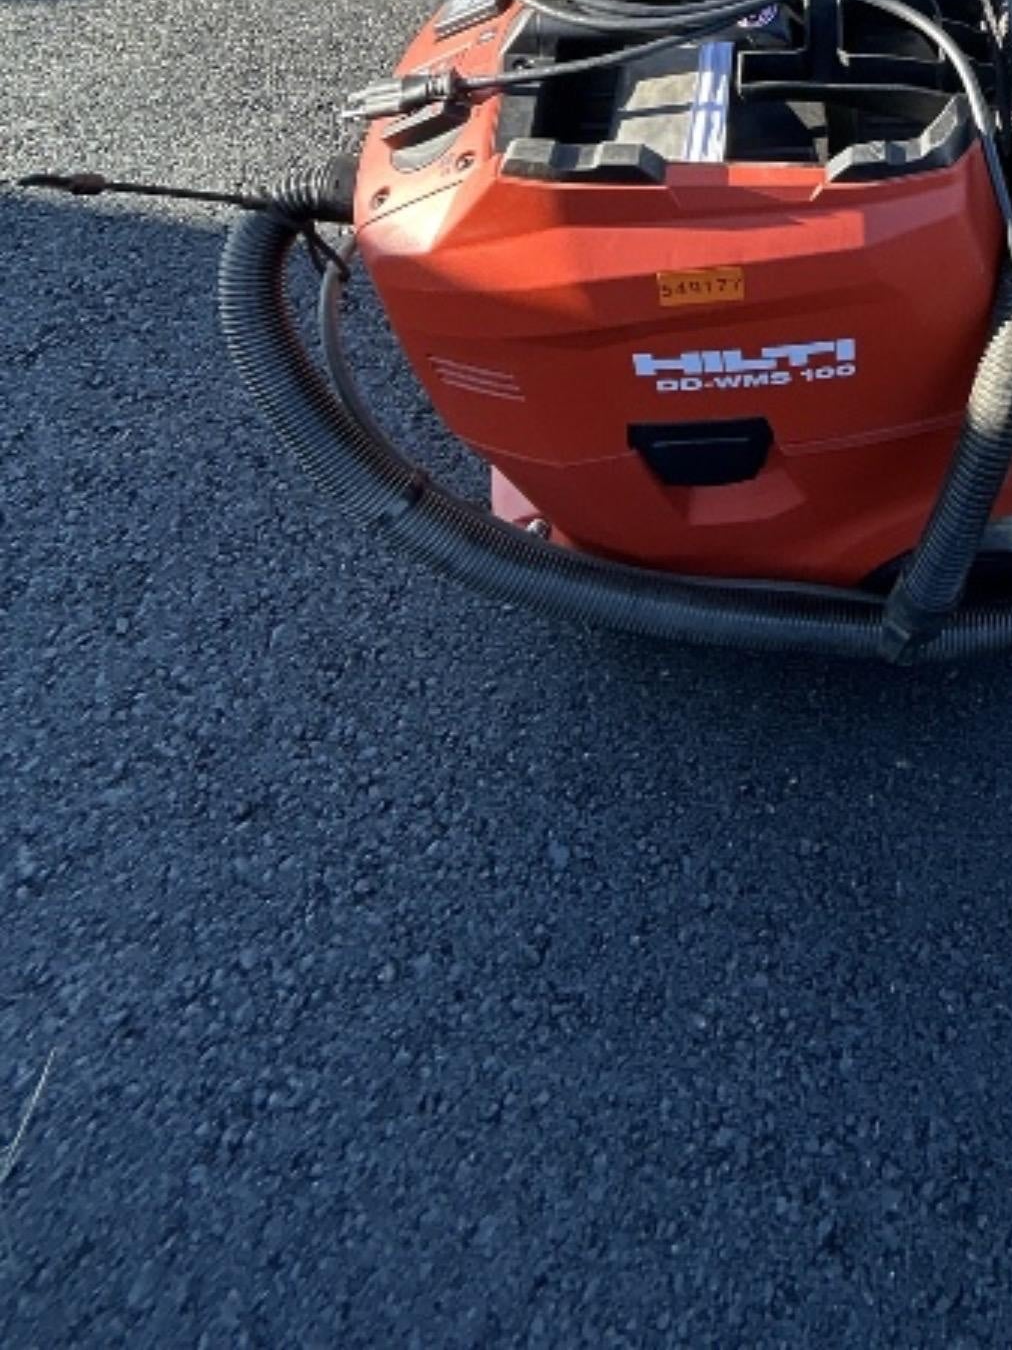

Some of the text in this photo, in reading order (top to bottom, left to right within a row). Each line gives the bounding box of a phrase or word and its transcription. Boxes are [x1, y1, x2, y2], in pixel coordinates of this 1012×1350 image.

[632, 338, 856, 376] HILTI
[656, 363, 856, 392] DD-WMS 100
